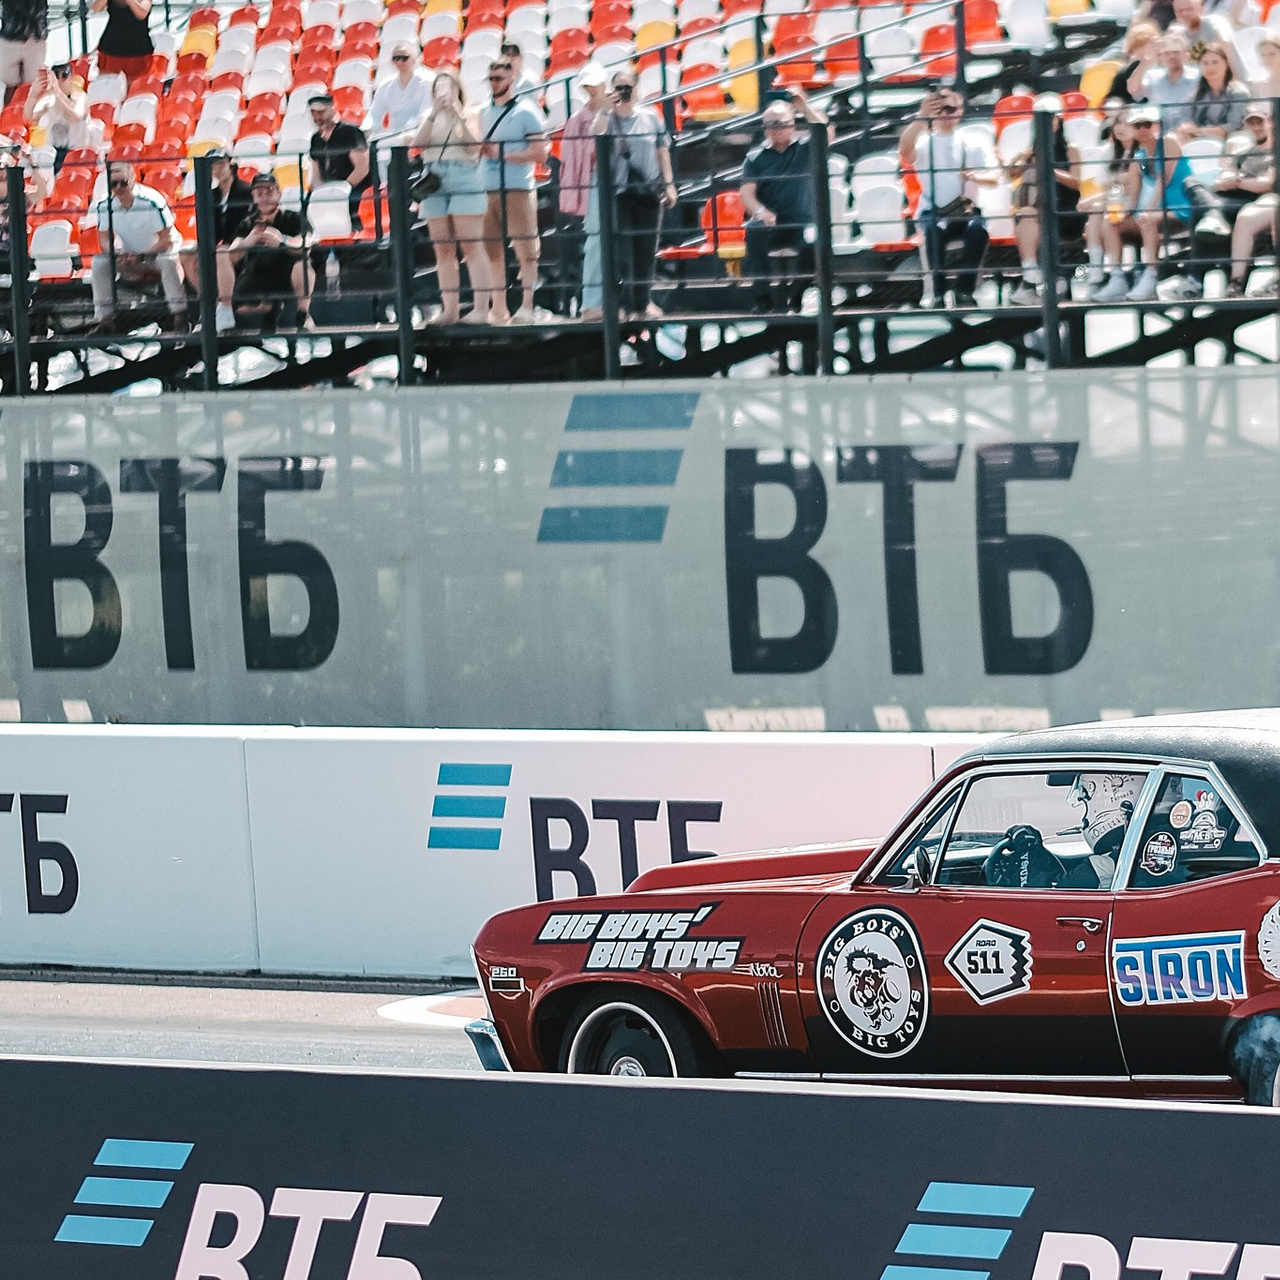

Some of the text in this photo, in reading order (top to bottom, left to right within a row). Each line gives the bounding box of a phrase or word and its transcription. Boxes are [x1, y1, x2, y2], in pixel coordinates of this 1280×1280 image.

[22, 456, 340, 672] ВТБ
[723, 441, 1095, 677] ВТБ
[538, 914, 602, 940] BIG
[586, 941, 741, 969] BIG TOYS
[749, 963, 783, 978] Nova
[824, 937, 846, 980] BIG
[966, 950, 1004, 975] 511
[1115, 933, 1244, 1003] STRON
[851, 988, 922, 1049] BIG TOYS
